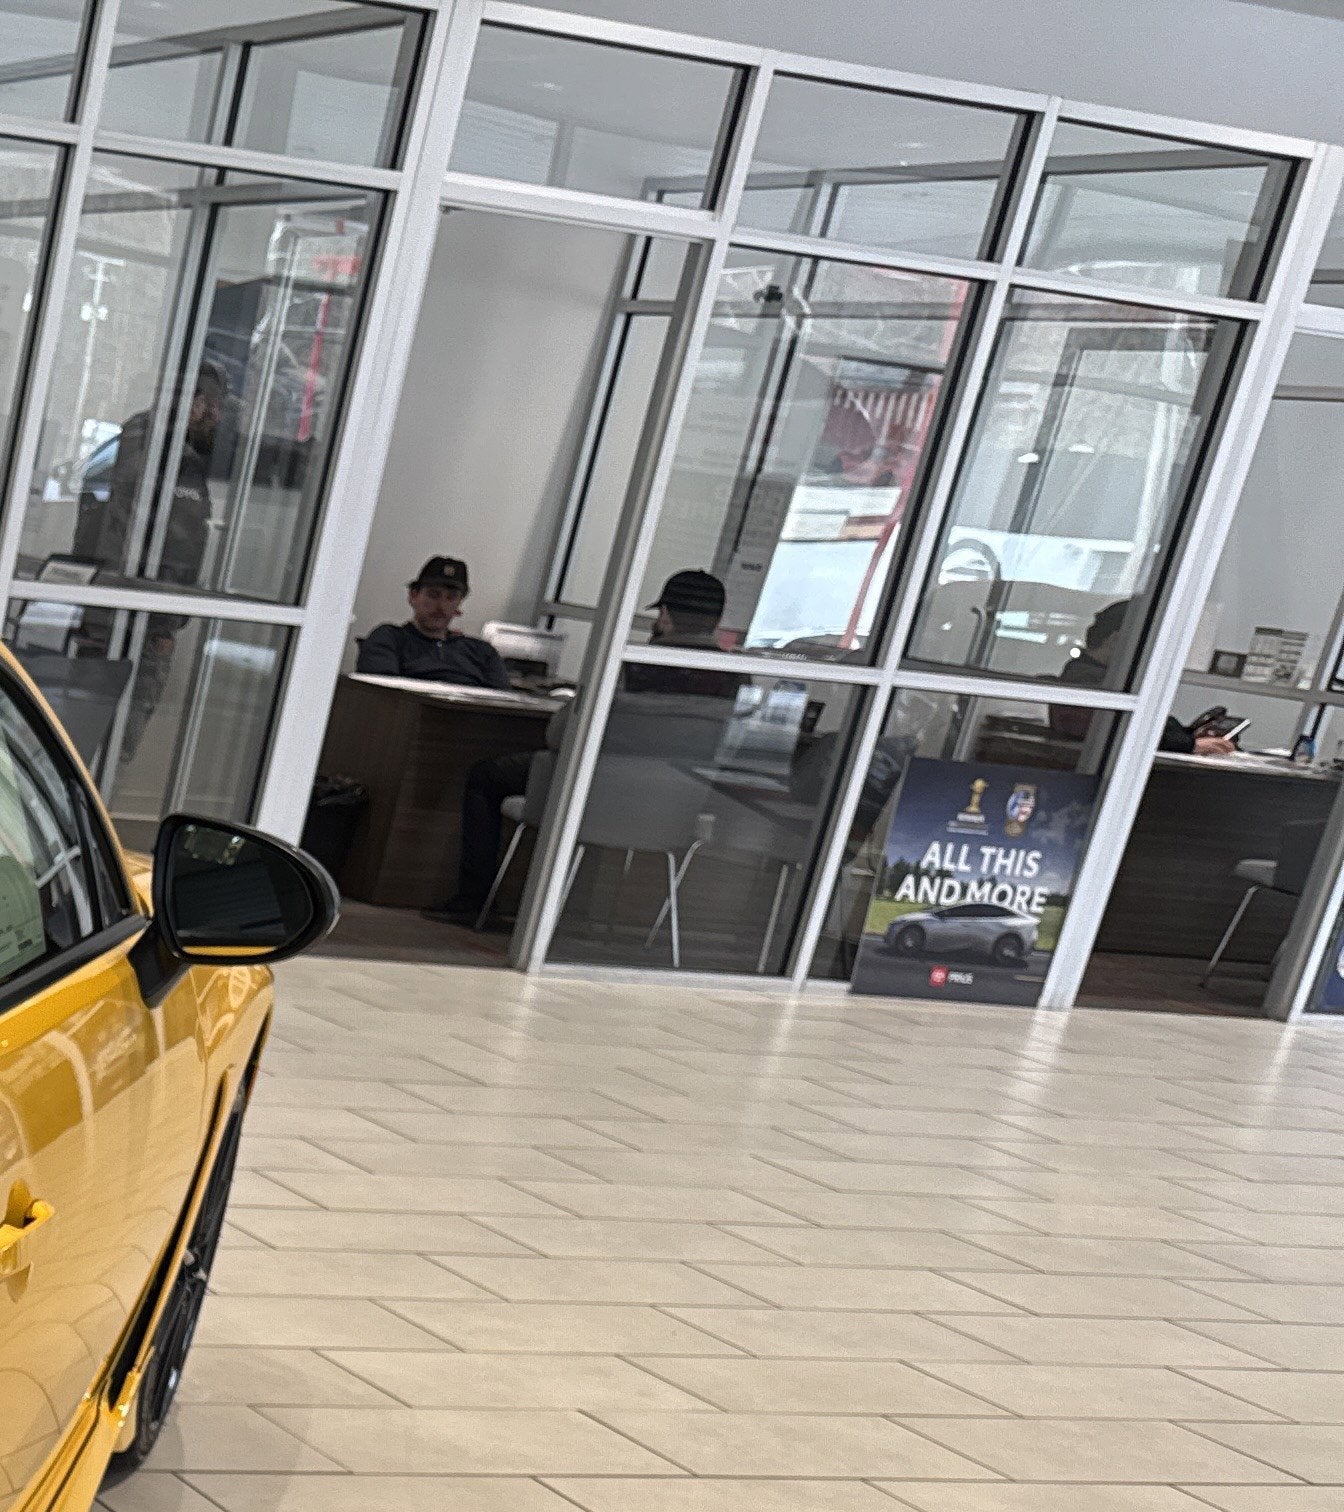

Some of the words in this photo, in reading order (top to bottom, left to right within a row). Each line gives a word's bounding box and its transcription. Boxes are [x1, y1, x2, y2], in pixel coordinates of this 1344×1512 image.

[920, 840, 971, 873] ALL
[980, 845, 1043, 879] THIS
[894, 873, 962, 906] AND
[965, 881, 1049, 914] MORE
